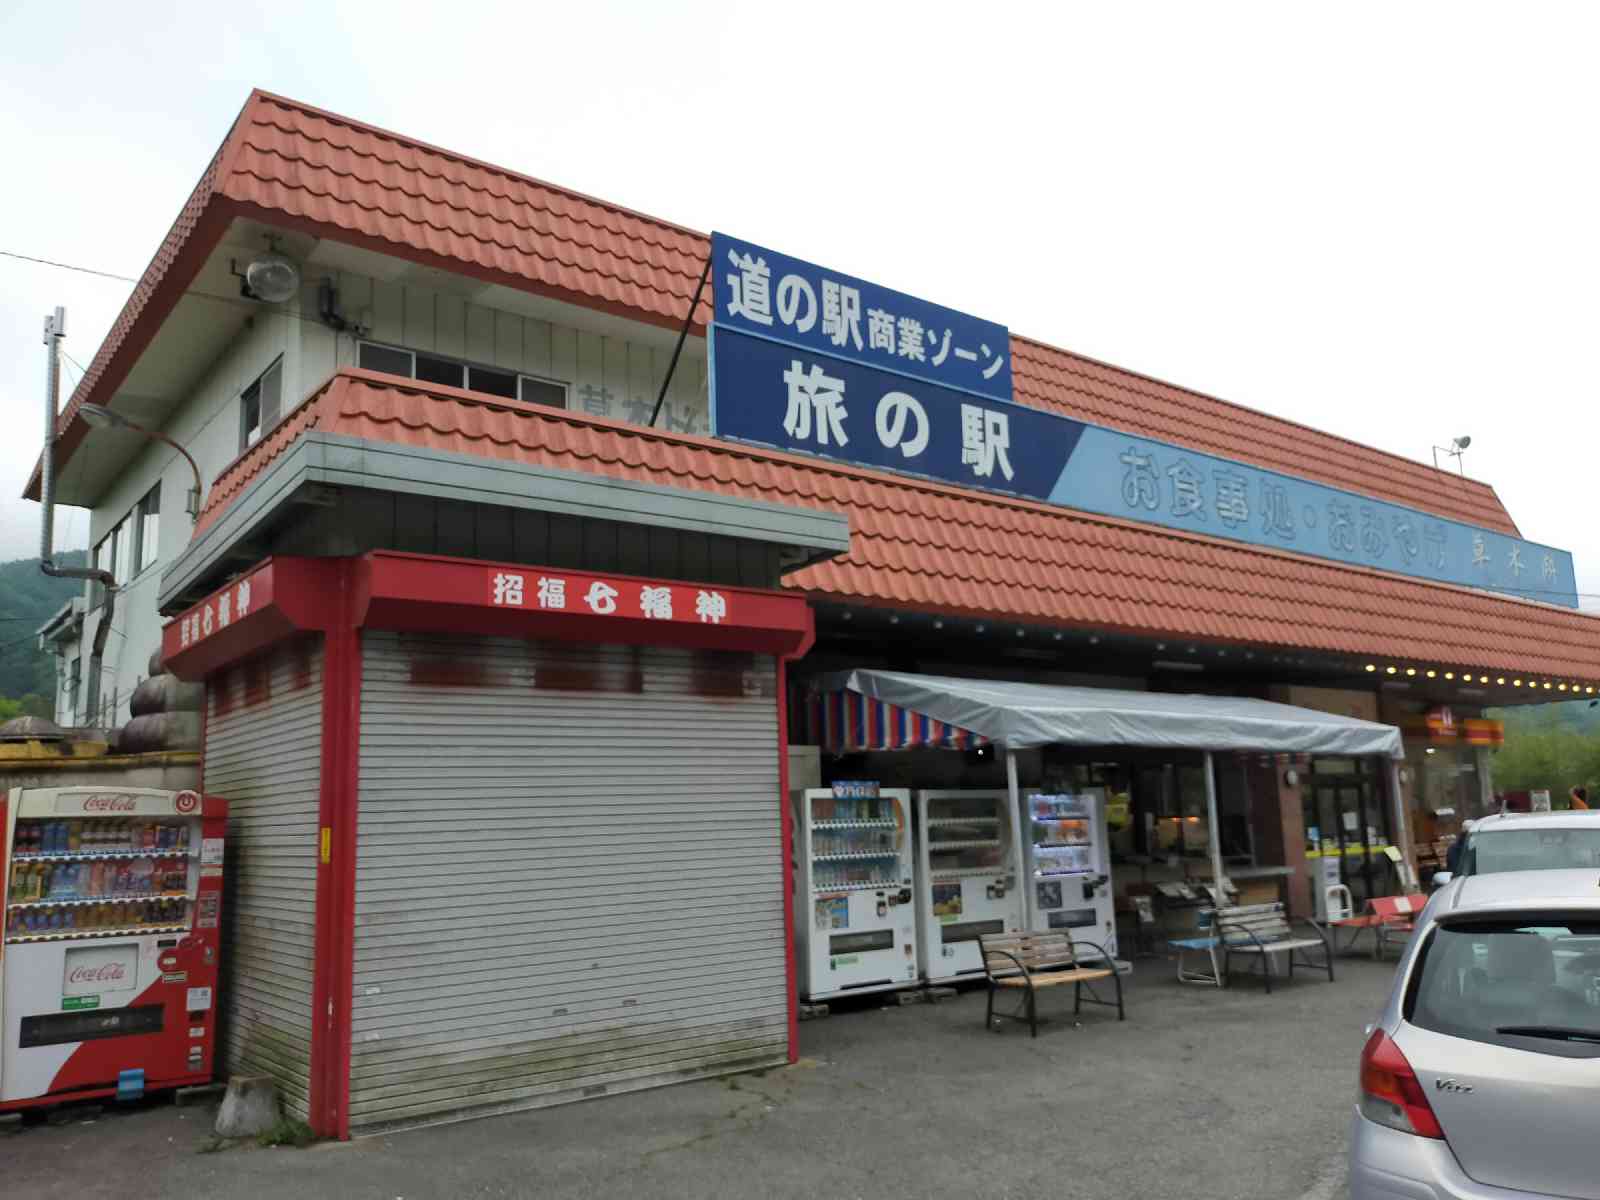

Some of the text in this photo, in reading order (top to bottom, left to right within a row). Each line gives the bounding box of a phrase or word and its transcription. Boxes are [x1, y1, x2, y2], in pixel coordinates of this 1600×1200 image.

[727, 249, 1004, 380] 道の駅商業ゾーン
[783, 360, 1014, 481] 旅の駅
[492, 572, 727, 625] 招福七福神
